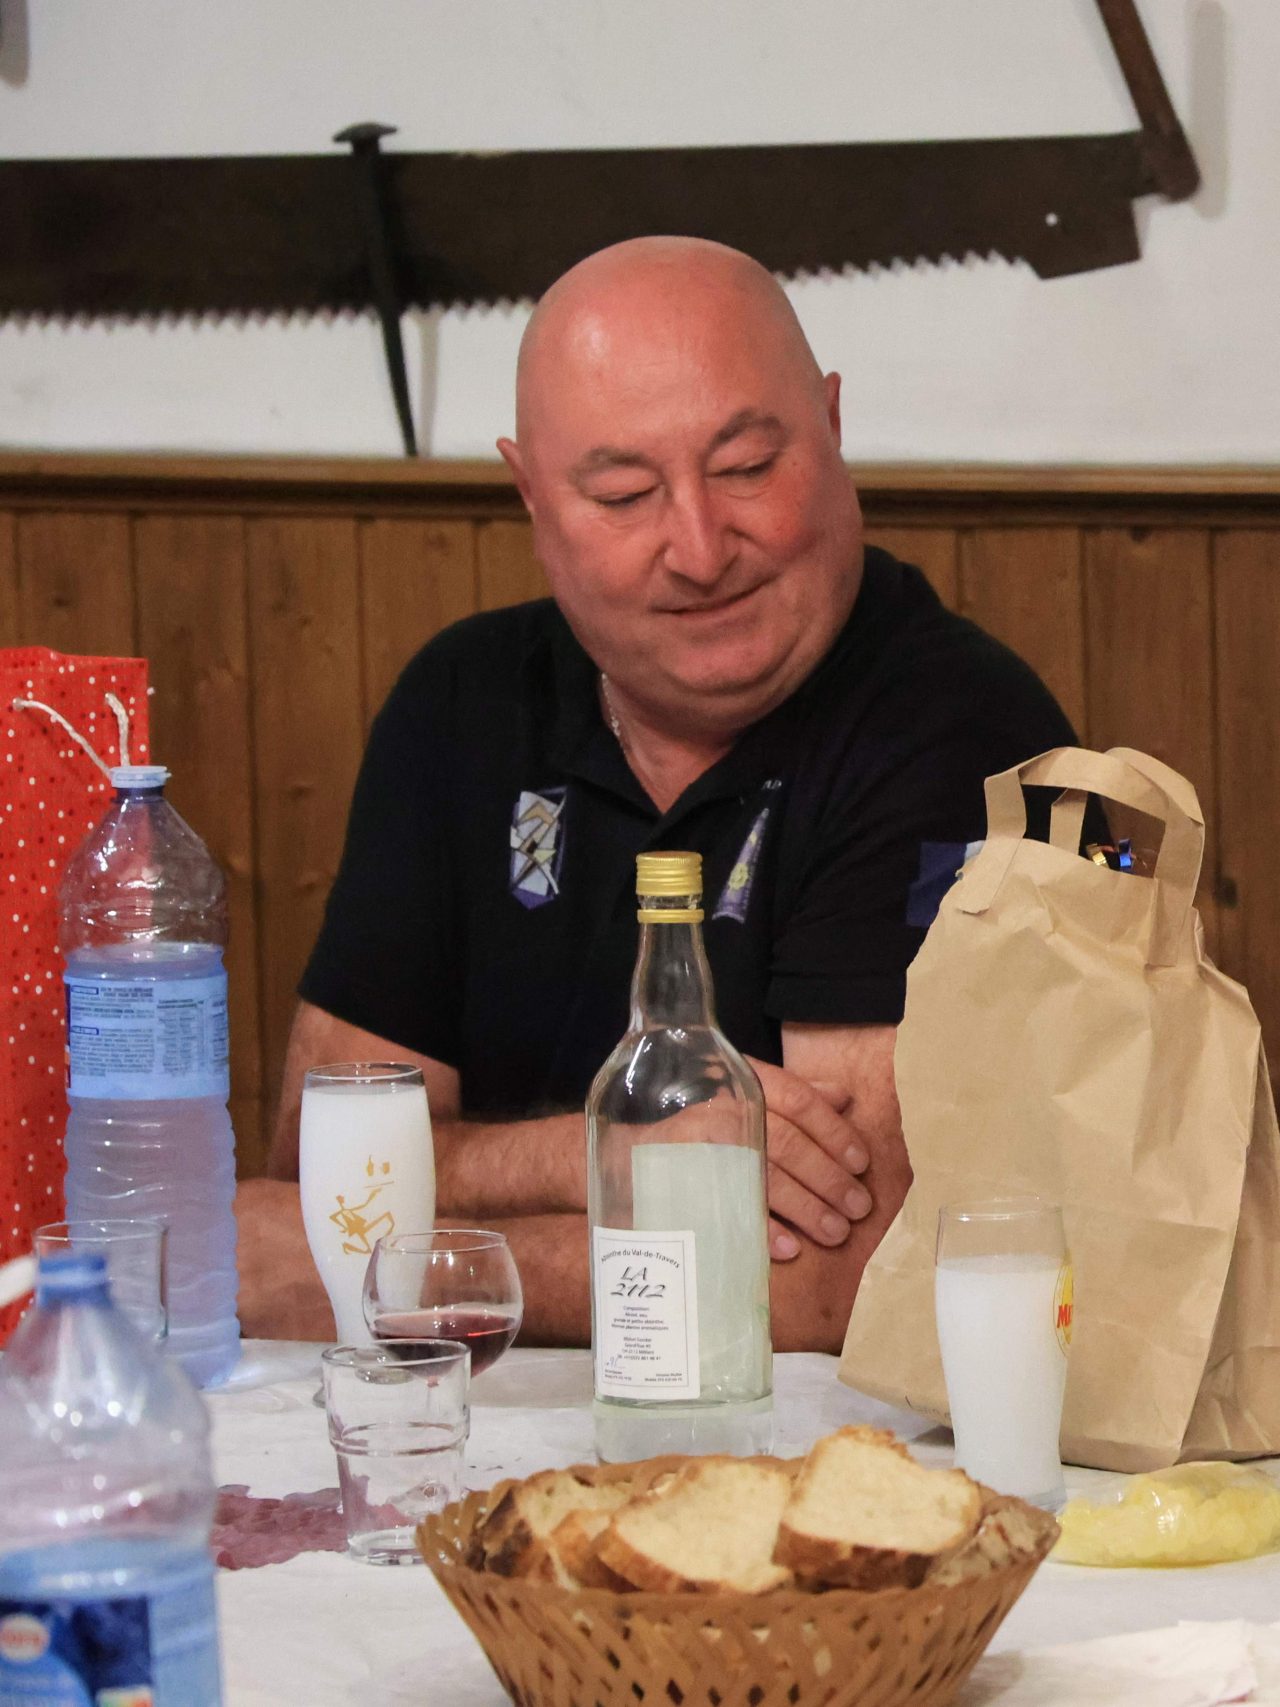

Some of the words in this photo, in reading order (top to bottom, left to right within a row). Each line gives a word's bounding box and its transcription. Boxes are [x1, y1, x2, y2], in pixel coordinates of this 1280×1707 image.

[622, 1248, 631, 1256] du
[632, 1249, 680, 1269] Val-de-Travers
[620, 1266, 647, 1281] LA
[610, 1283, 666, 1298] 2112
